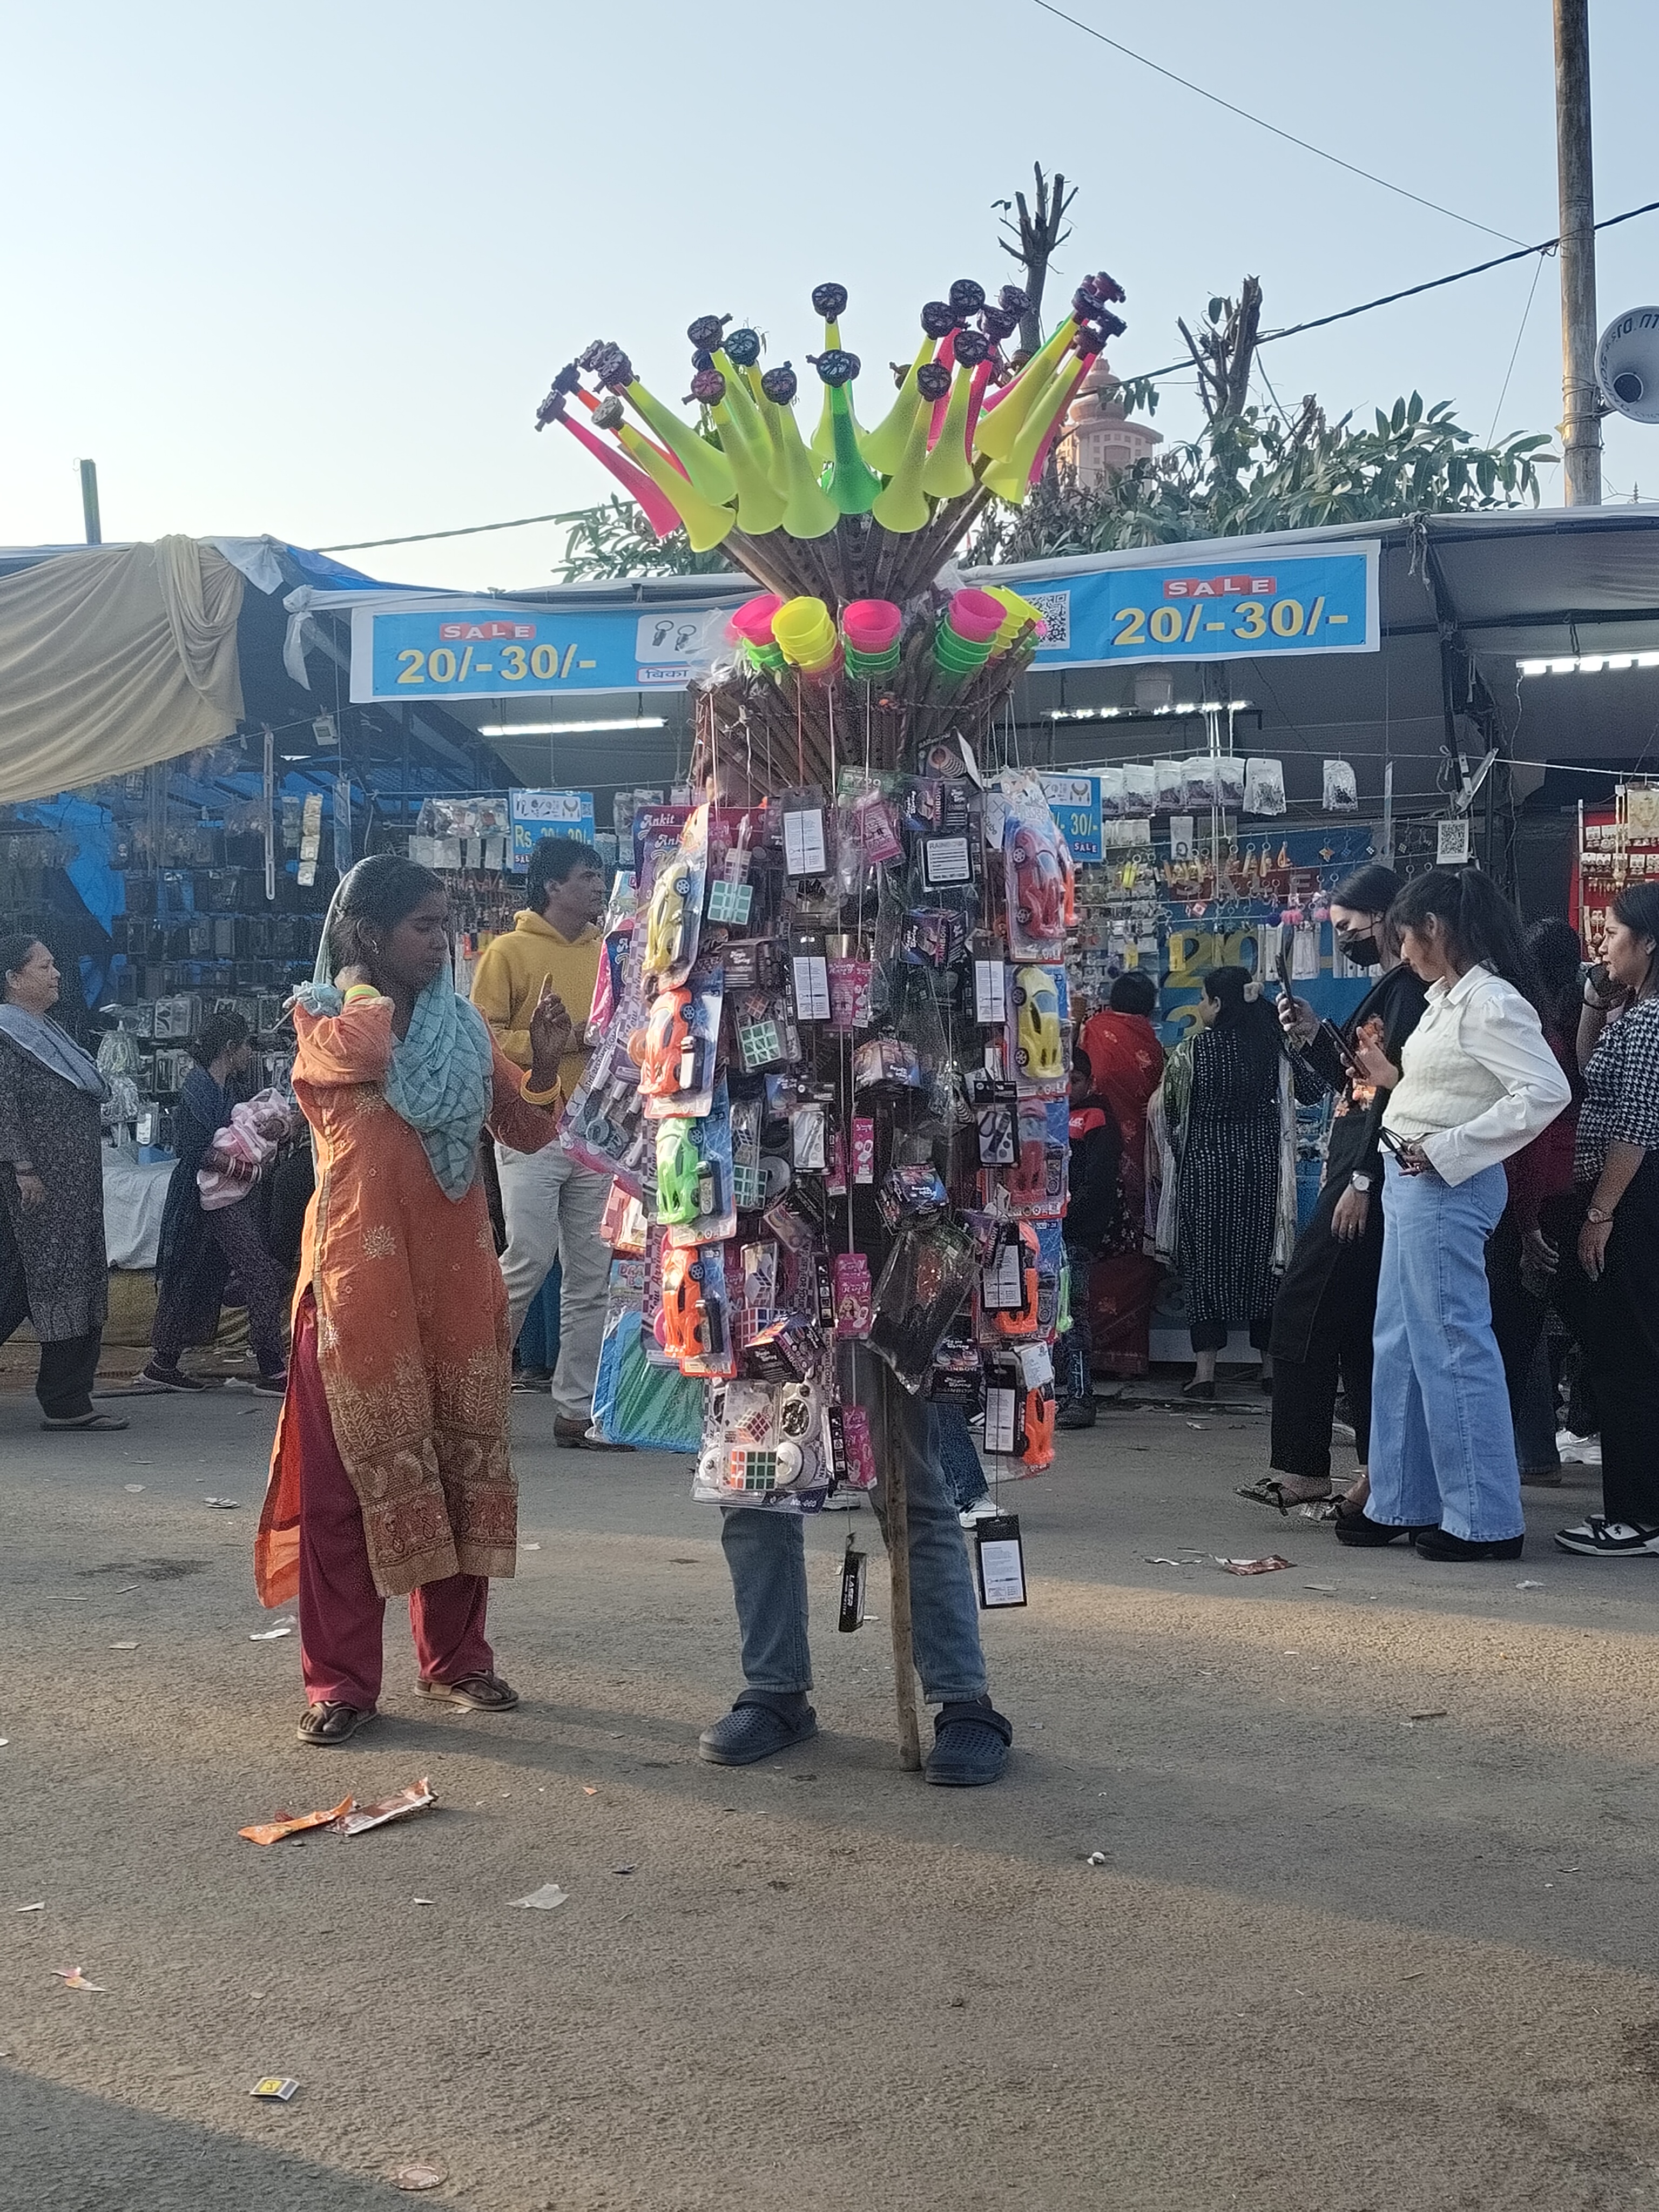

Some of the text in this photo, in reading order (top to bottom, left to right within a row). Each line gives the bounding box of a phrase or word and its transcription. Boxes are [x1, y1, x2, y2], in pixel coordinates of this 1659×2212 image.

[1169, 577, 1270, 595] SALE
[444, 623, 532, 639] SALE
[640, 813, 676, 828] Ankit
[1071, 813, 1098, 836] 30/-
[1074, 842, 1097, 853] SALE
[515, 855, 530, 863] SAL
